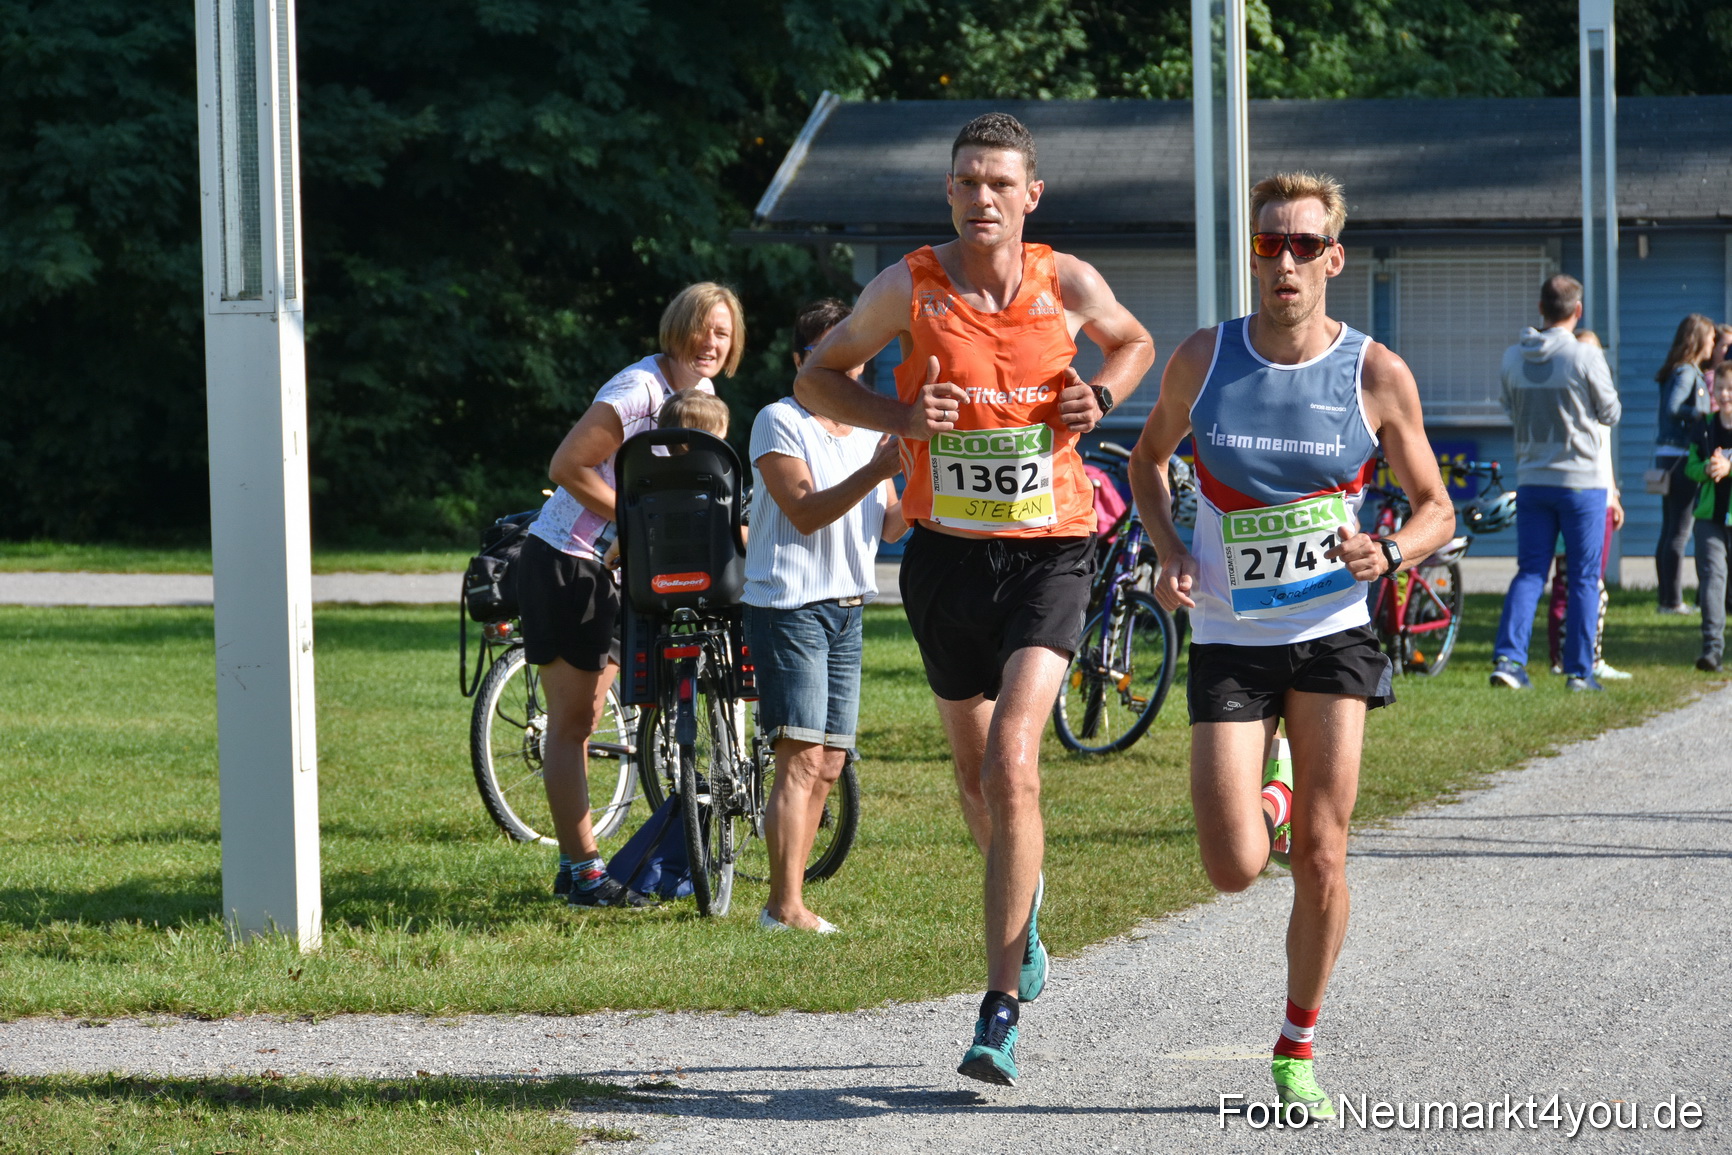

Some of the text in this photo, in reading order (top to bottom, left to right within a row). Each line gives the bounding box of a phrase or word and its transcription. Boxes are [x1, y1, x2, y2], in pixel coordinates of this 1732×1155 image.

[1028, 307, 1060, 316] adidas
[965, 385, 1049, 404] FitterTEC
[938, 428, 1042, 456] BOCK
[1206, 423, 1346, 457] team memmert
[947, 462, 1038, 495] 1362
[965, 497, 1042, 519] STEFAN
[1231, 498, 1337, 539] BOCK
[1240, 534, 1338, 581] 2741
[1260, 579, 1332, 606] Jonathan
